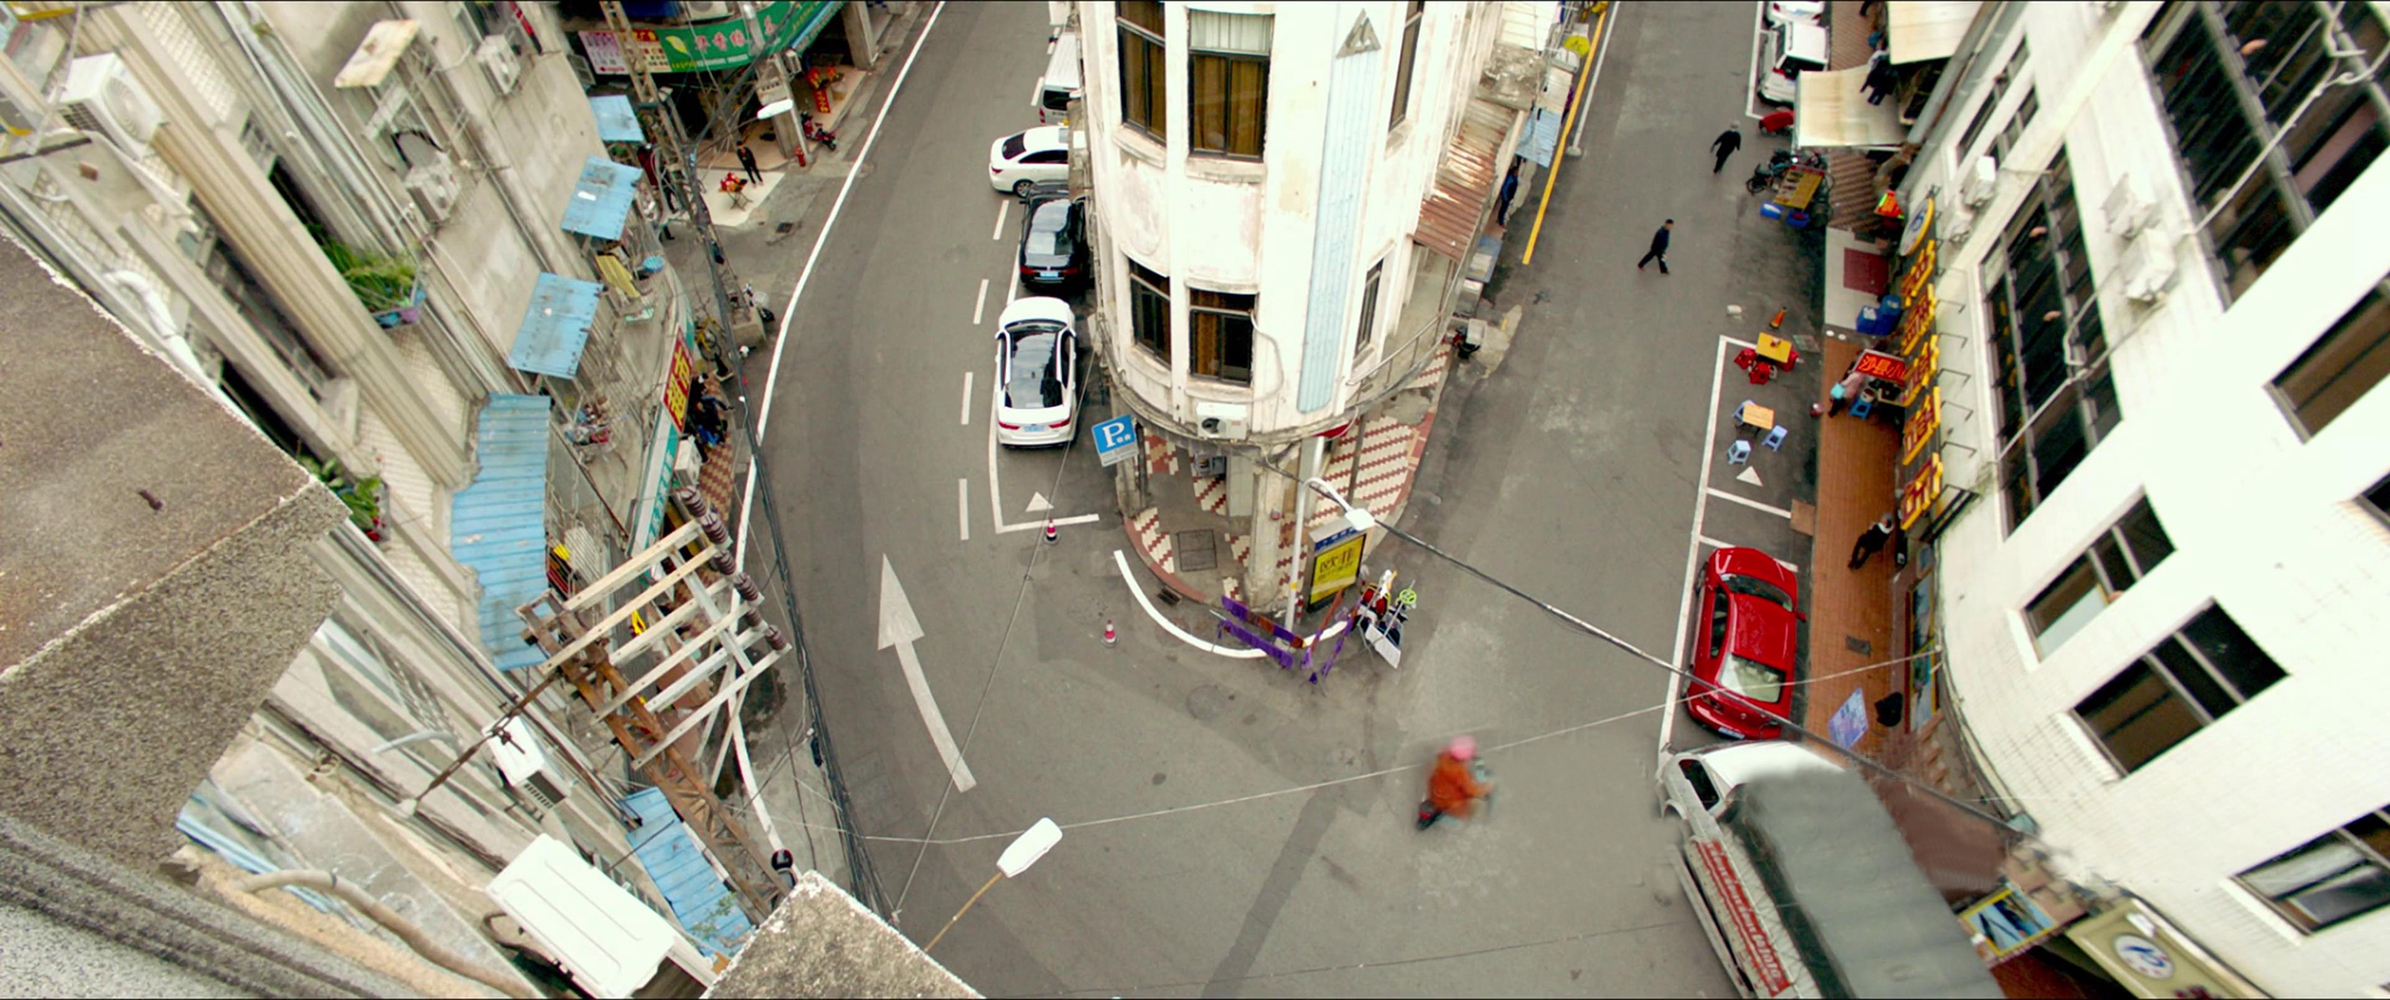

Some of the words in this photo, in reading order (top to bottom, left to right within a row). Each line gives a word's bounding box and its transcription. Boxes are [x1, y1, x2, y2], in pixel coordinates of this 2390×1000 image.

[1858, 354, 1906, 380] 沙县小
[1102, 421, 1125, 448] P
